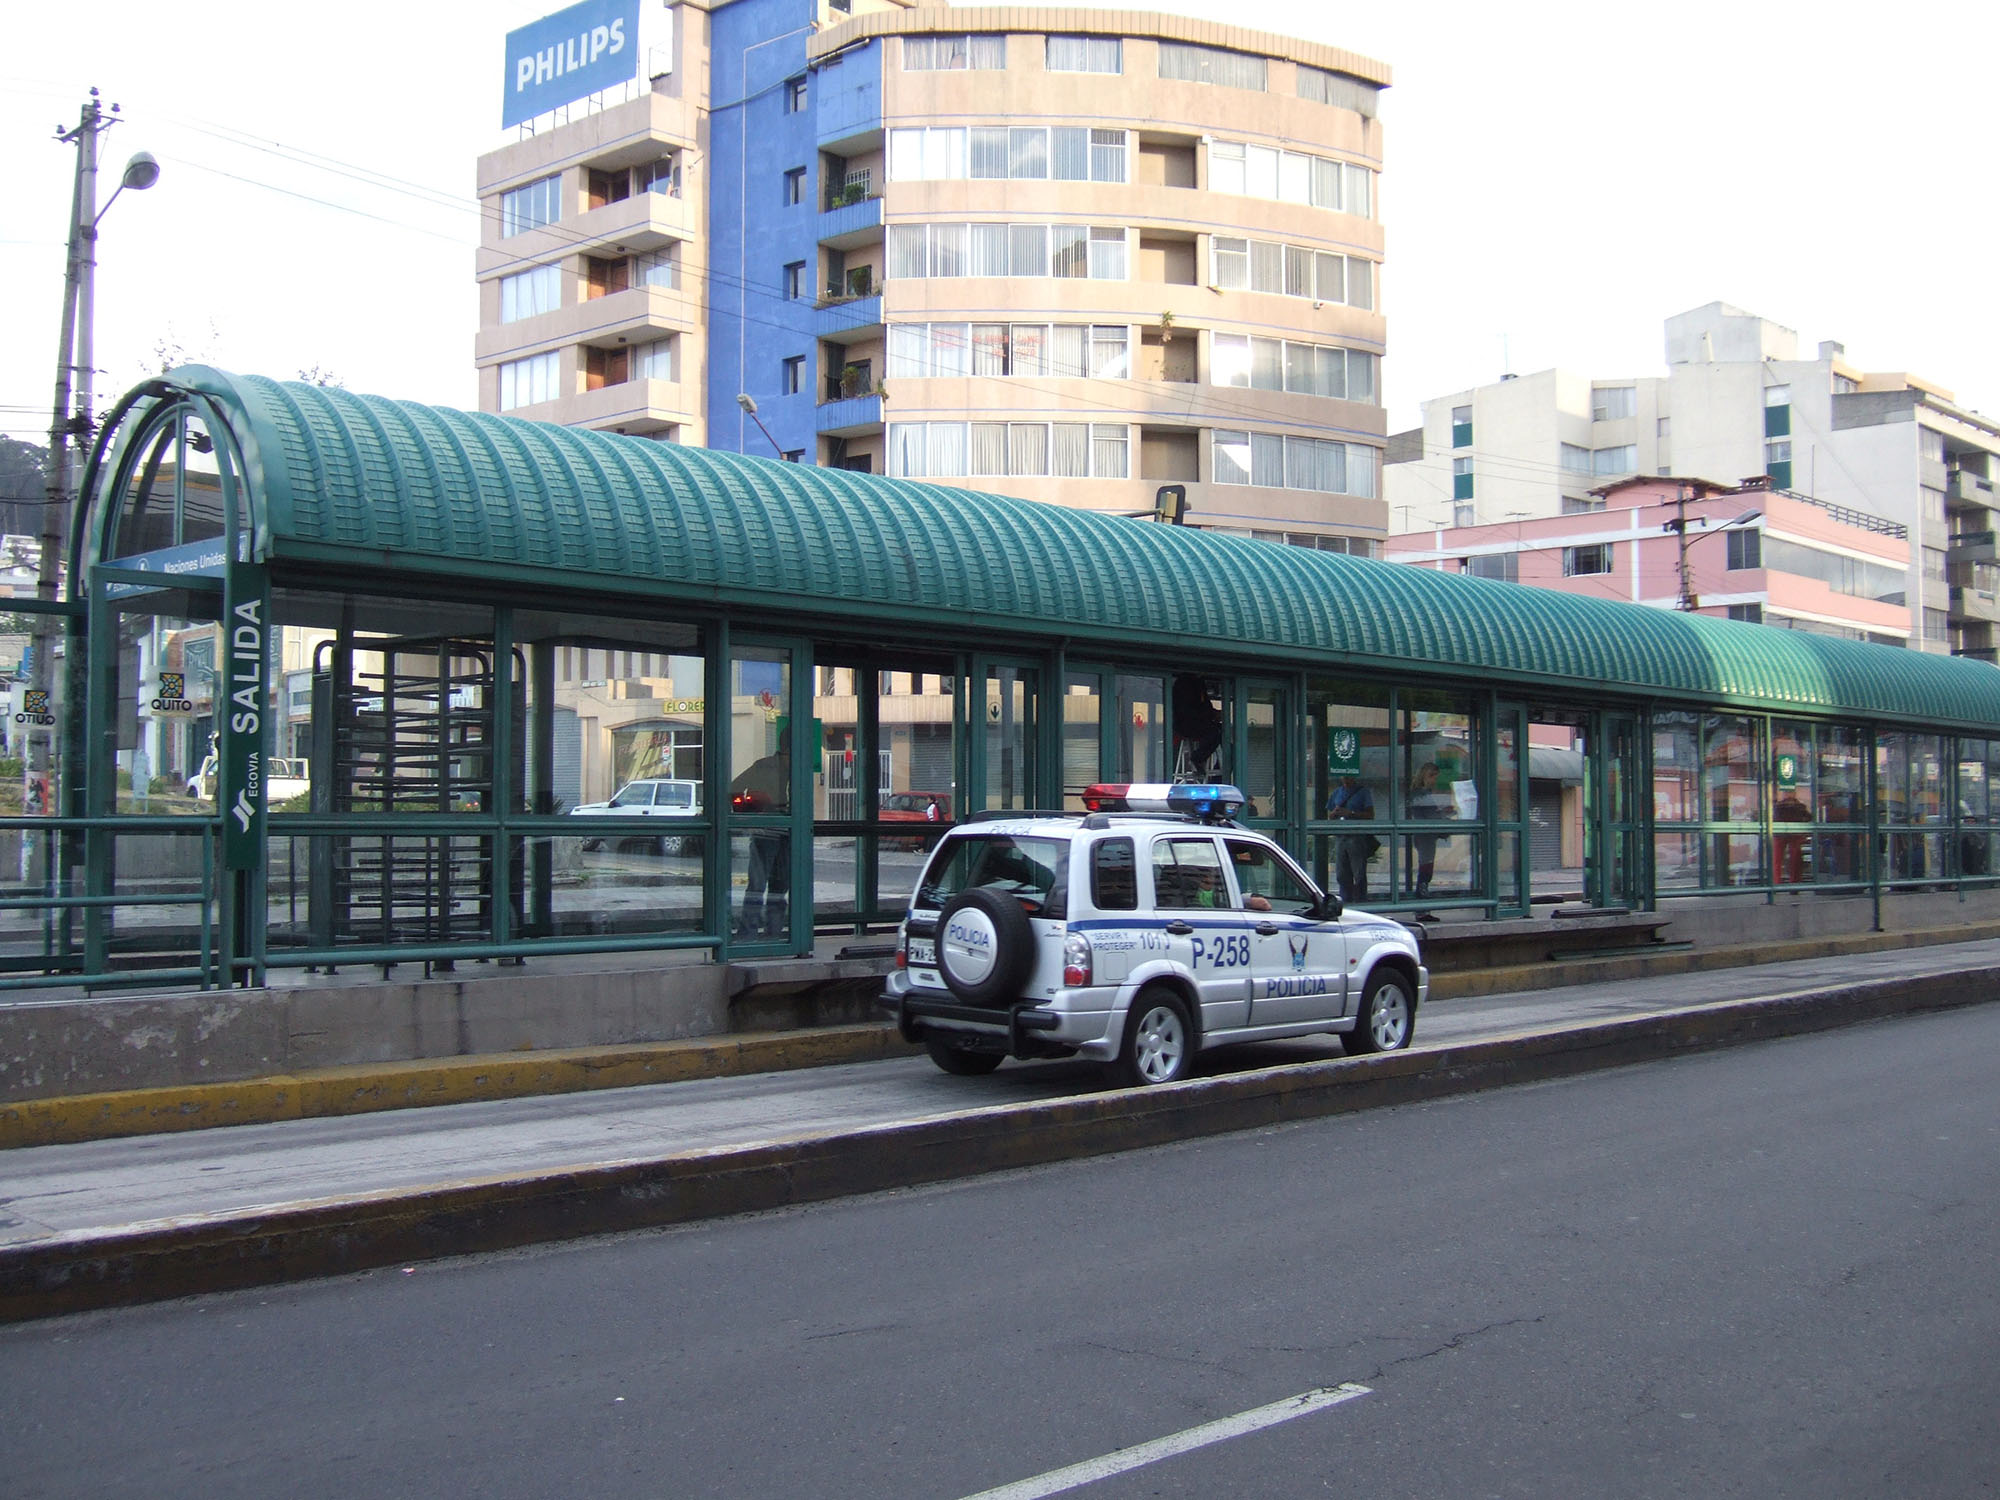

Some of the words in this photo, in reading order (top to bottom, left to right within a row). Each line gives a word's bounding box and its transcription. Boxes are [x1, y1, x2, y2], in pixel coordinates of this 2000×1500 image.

[517, 18, 625, 92] PHILIPS
[164, 558, 199, 574] Naciones
[200, 551, 226, 569] Unidas
[232, 599, 261, 734] SALIDA
[151, 699, 192, 712] QUITO
[248, 752, 258, 797] ECOVIA
[950, 924, 990, 948] POLICIA
[1191, 935, 1250, 969] P-258
[1266, 976, 1326, 998] POLICIA
